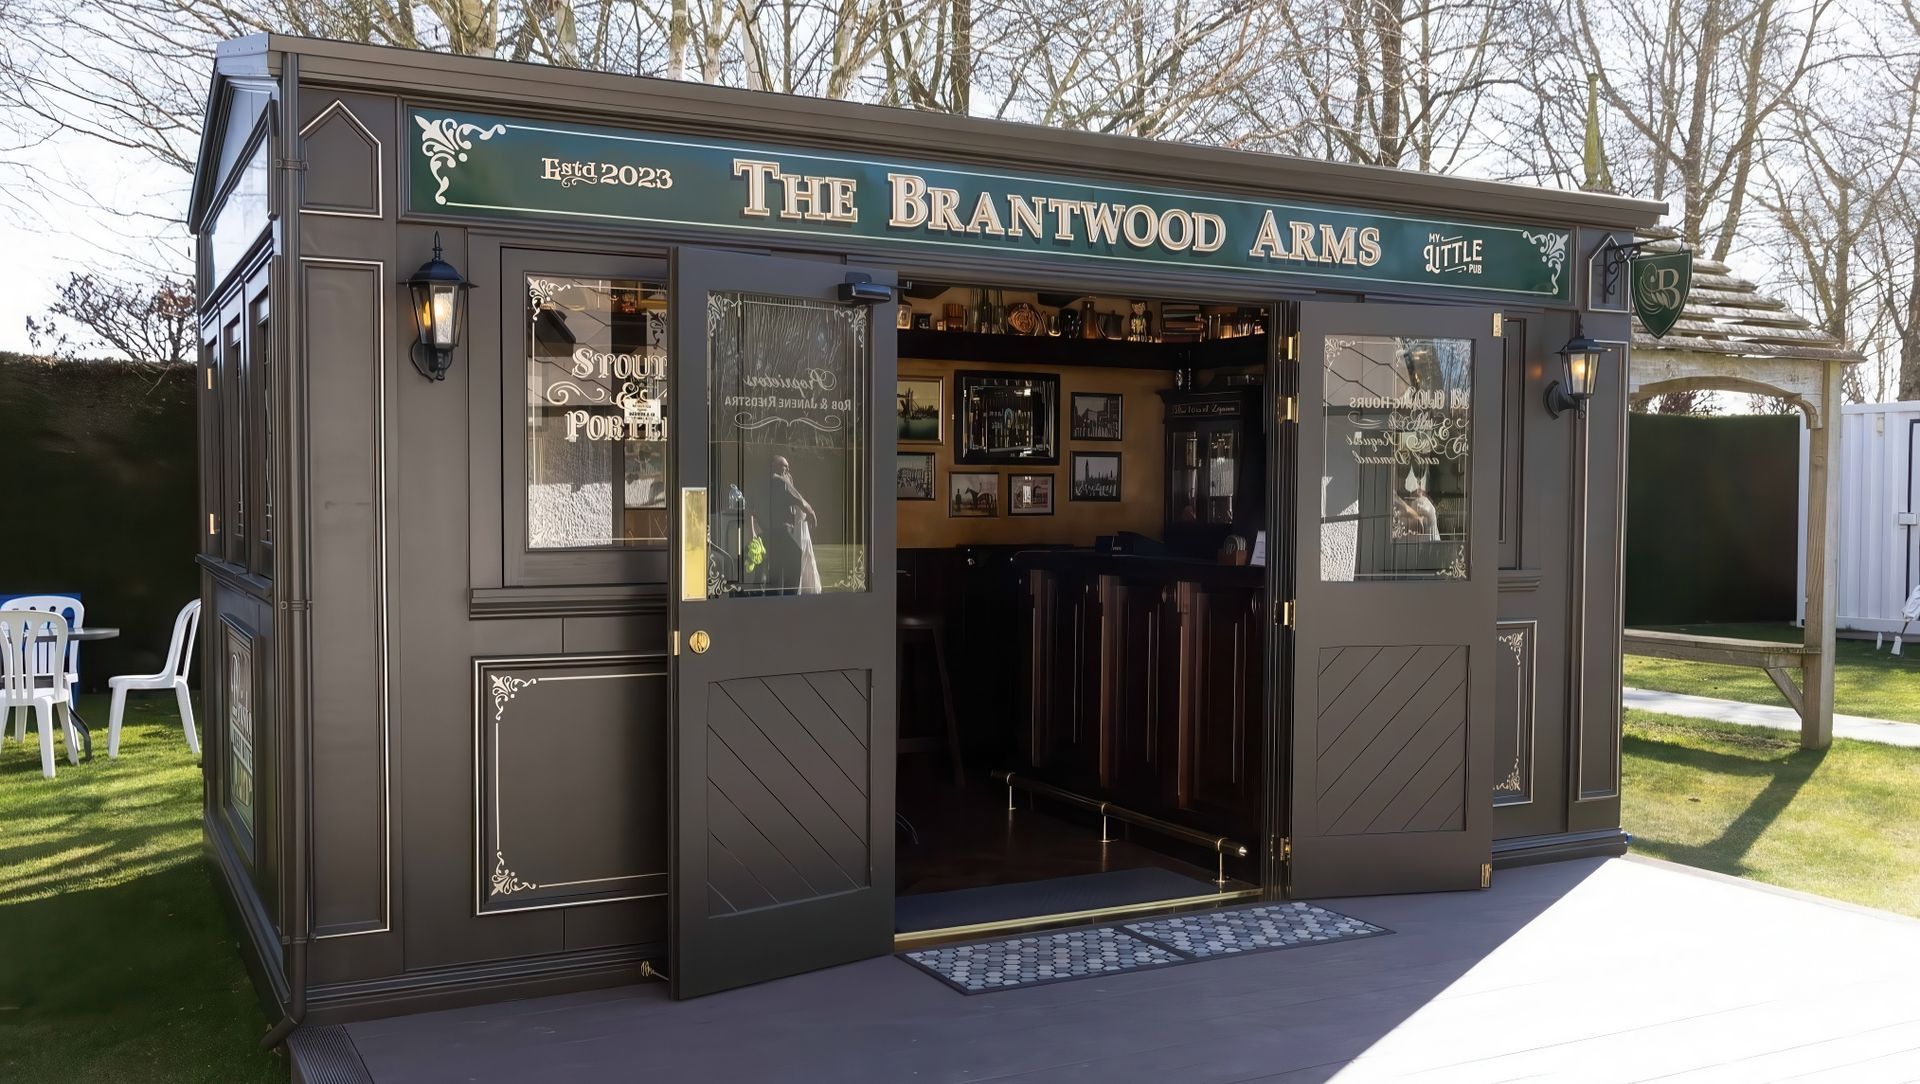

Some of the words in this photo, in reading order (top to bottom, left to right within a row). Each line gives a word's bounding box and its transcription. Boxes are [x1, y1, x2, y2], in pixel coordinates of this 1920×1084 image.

[600, 163, 674, 190] 2023
[733, 158, 859, 223] THE
[887, 172, 1227, 253] BRANTWOOD
[1249, 209, 1382, 267] ARMS
[1428, 233, 1441, 243] MY
[1423, 239, 1483, 274] LITTLE
[1468, 263, 1483, 275] PUB
